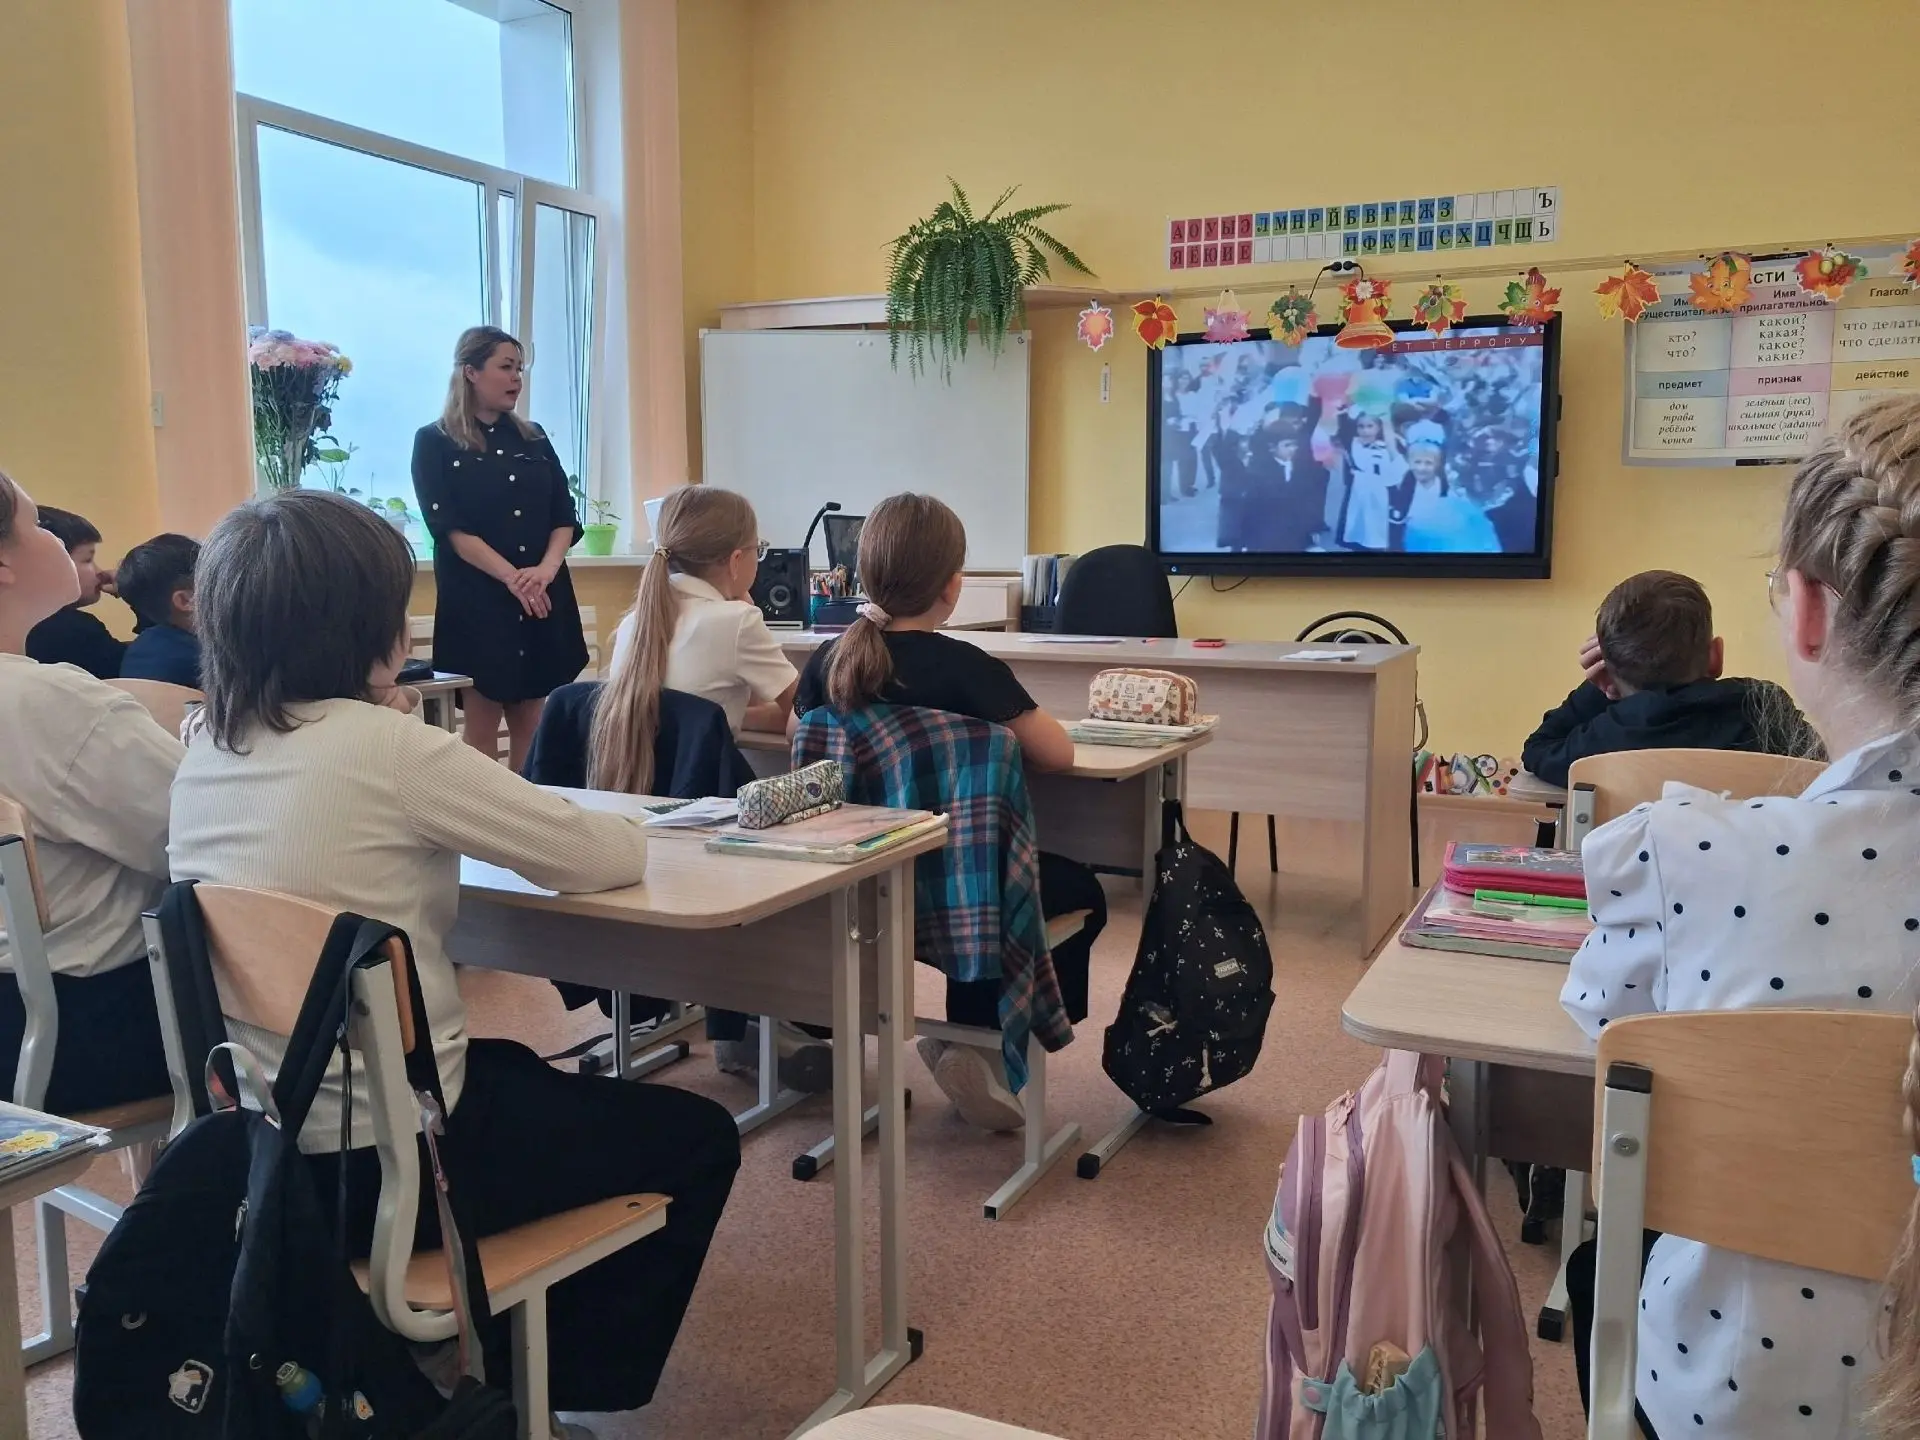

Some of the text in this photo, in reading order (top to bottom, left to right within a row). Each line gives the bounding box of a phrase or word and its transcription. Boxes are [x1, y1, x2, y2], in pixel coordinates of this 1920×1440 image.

[1749, 270, 1785, 284] СТИ
[1773, 289, 1796, 299] Имя
[1869, 287, 1909, 297] Глагол
[1673, 298, 1689, 307] Им
[1759, 313, 1807, 327] какой?
[1843, 321, 1867, 331] что
[1668, 331, 1697, 343] кто?
[1759, 325, 1805, 339] какая?
[1392, 336, 1526, 352] ЕТ ТЕРРОРУ
[1759, 337, 1804, 351] какое?
[1839, 338, 1863, 348] что
[1667, 346, 1696, 358] что?
[1757, 349, 1804, 363] какие?
[1758, 375, 1802, 386] признак
[1855, 369, 1910, 381] действие
[1658, 380, 1703, 391] предмет
[1669, 401, 1688, 411] дом
[1663, 412, 1694, 424] трава
[1740, 407, 1815, 420] сильная (рука)
[1658, 424, 1697, 435] ребёнок
[1728, 422, 1776, 431] школьное
[1662, 436, 1693, 445] кошка
